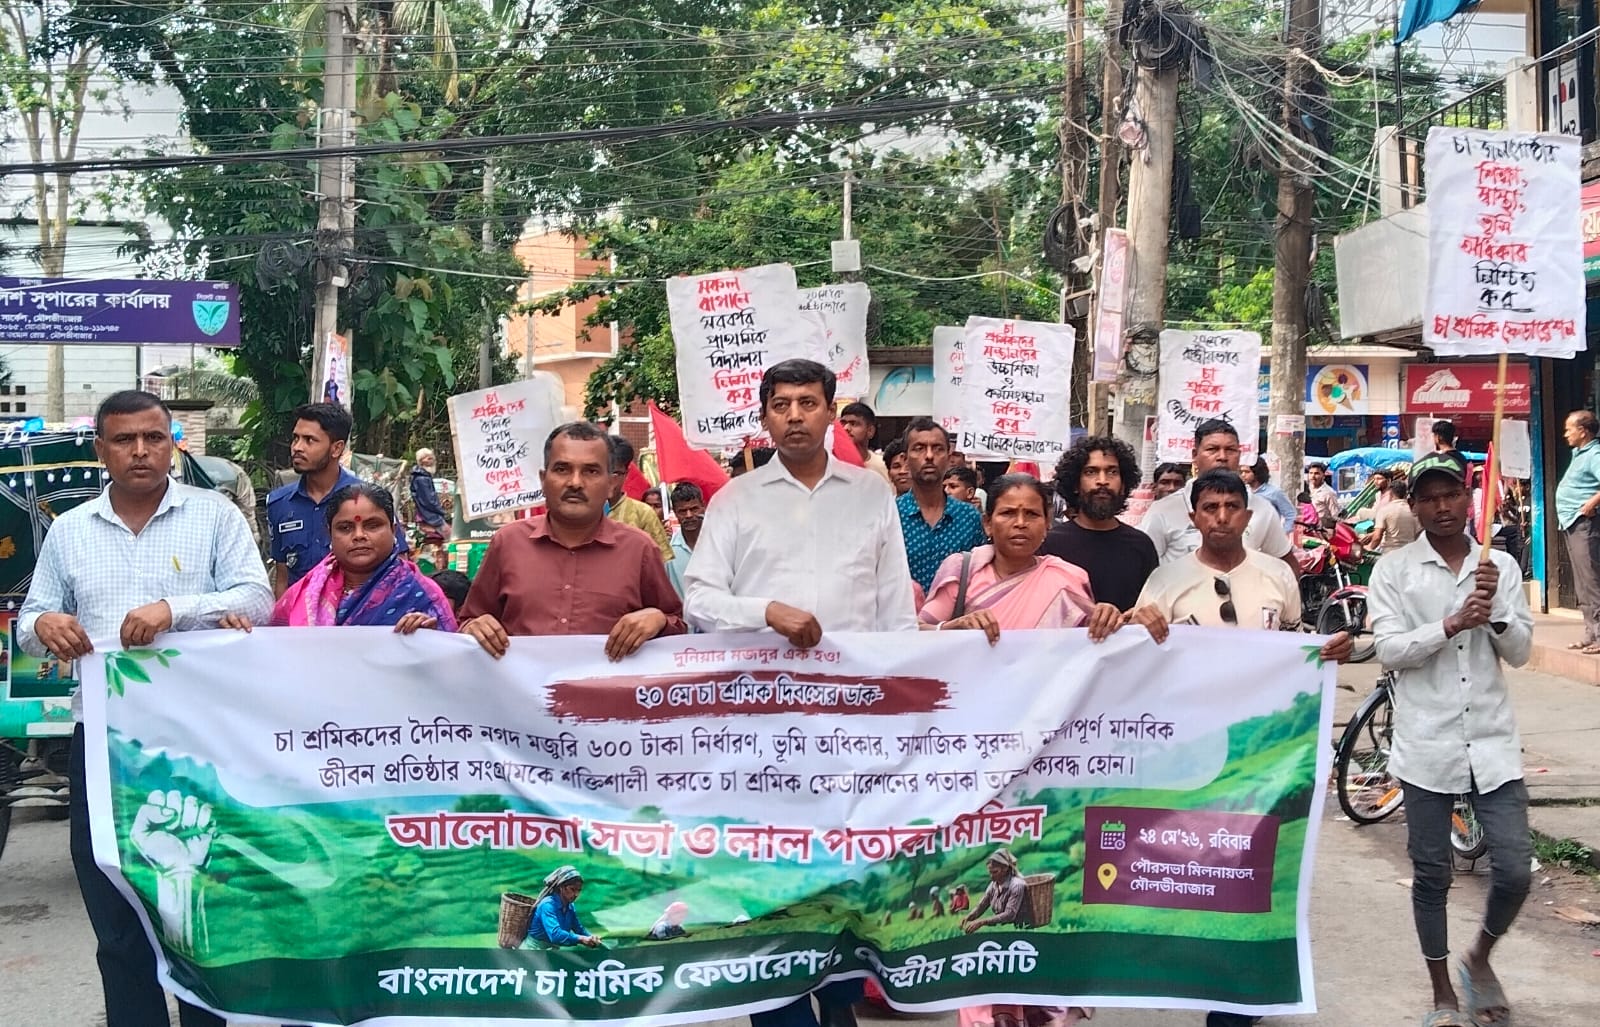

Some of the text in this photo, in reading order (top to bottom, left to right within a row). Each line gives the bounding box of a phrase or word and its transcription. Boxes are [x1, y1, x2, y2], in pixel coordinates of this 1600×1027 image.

[1453, 136, 1471, 155] চা
[29, 290, 99, 311] সুপারের
[103, 289, 172, 309] কার্যালয়
[1004, 323, 1014, 334] চা
[1434, 316, 1449, 338] চা
[1452, 313, 1499, 338] শ্রমিক
[702, 328, 769, 349] প্রাথমিক
[1202, 367, 1218, 380] চা
[726, 387, 755, 404] কর
[698, 419, 711, 434] চা
[712, 412, 746, 432] শ্রমিক
[964, 432, 976, 448] চা
[978, 433, 1012, 451] শ্রমিক
[673, 648, 841, 667] দুনিয়ার মজদুর এক হও!
[637, 686, 662, 706] ২০
[669, 684, 690, 704] মে
[698, 682, 715, 704] চা
[720, 677, 772, 704] শ্রমিক
[777, 676, 839, 706] দিবসের
[274, 730, 293, 751] চা
[302, 721, 402, 751] শ্রমিকদের
[408, 716, 473, 748] দৈনিক
[480, 725, 520, 748] নগদ
[527, 731, 578, 760] মজুরি
[588, 740, 632, 758] ৬০০
[640, 731, 684, 756] টাকা
[692, 726, 763, 759] নির্ধারণ,
[772, 727, 807, 763] ভূমি
[815, 728, 889, 760] অধিকার,
[896, 727, 967, 757] সামাজিক
[973, 731, 1032, 760] সুরক্ষা,
[1109, 713, 1175, 741] মানবিক
[319, 757, 375, 789] জীবন
[384, 754, 460, 785] প্রতিষ্ঠার
[468, 759, 553, 786] সংগ্রামকে
[561, 765, 648, 793] শক্তিশালী
[656, 771, 714, 792] করতে
[720, 769, 738, 792] চা
[745, 764, 801, 793] শ্রমিক
[810, 771, 921, 796] ফেডারেশনের
[925, 769, 979, 793] পতাকা
[1032, 755, 1080, 777] ক্যবদ্ধ
[389, 801, 1044, 862] আলোচনা সভা ও লাল পতাকা মিছিল
[1139, 828, 1156, 844] ২৪
[1209, 828, 1252, 851] রবিবার
[1131, 858, 1185, 876] পৌরসভা
[1131, 877, 1216, 896] মৌলভীবাজার
[378, 965, 527, 996] বাংলাদেশ
[535, 968, 567, 997] চা
[574, 958, 664, 999] শ্রমিক
[951, 941, 1039, 978] কমিটি
